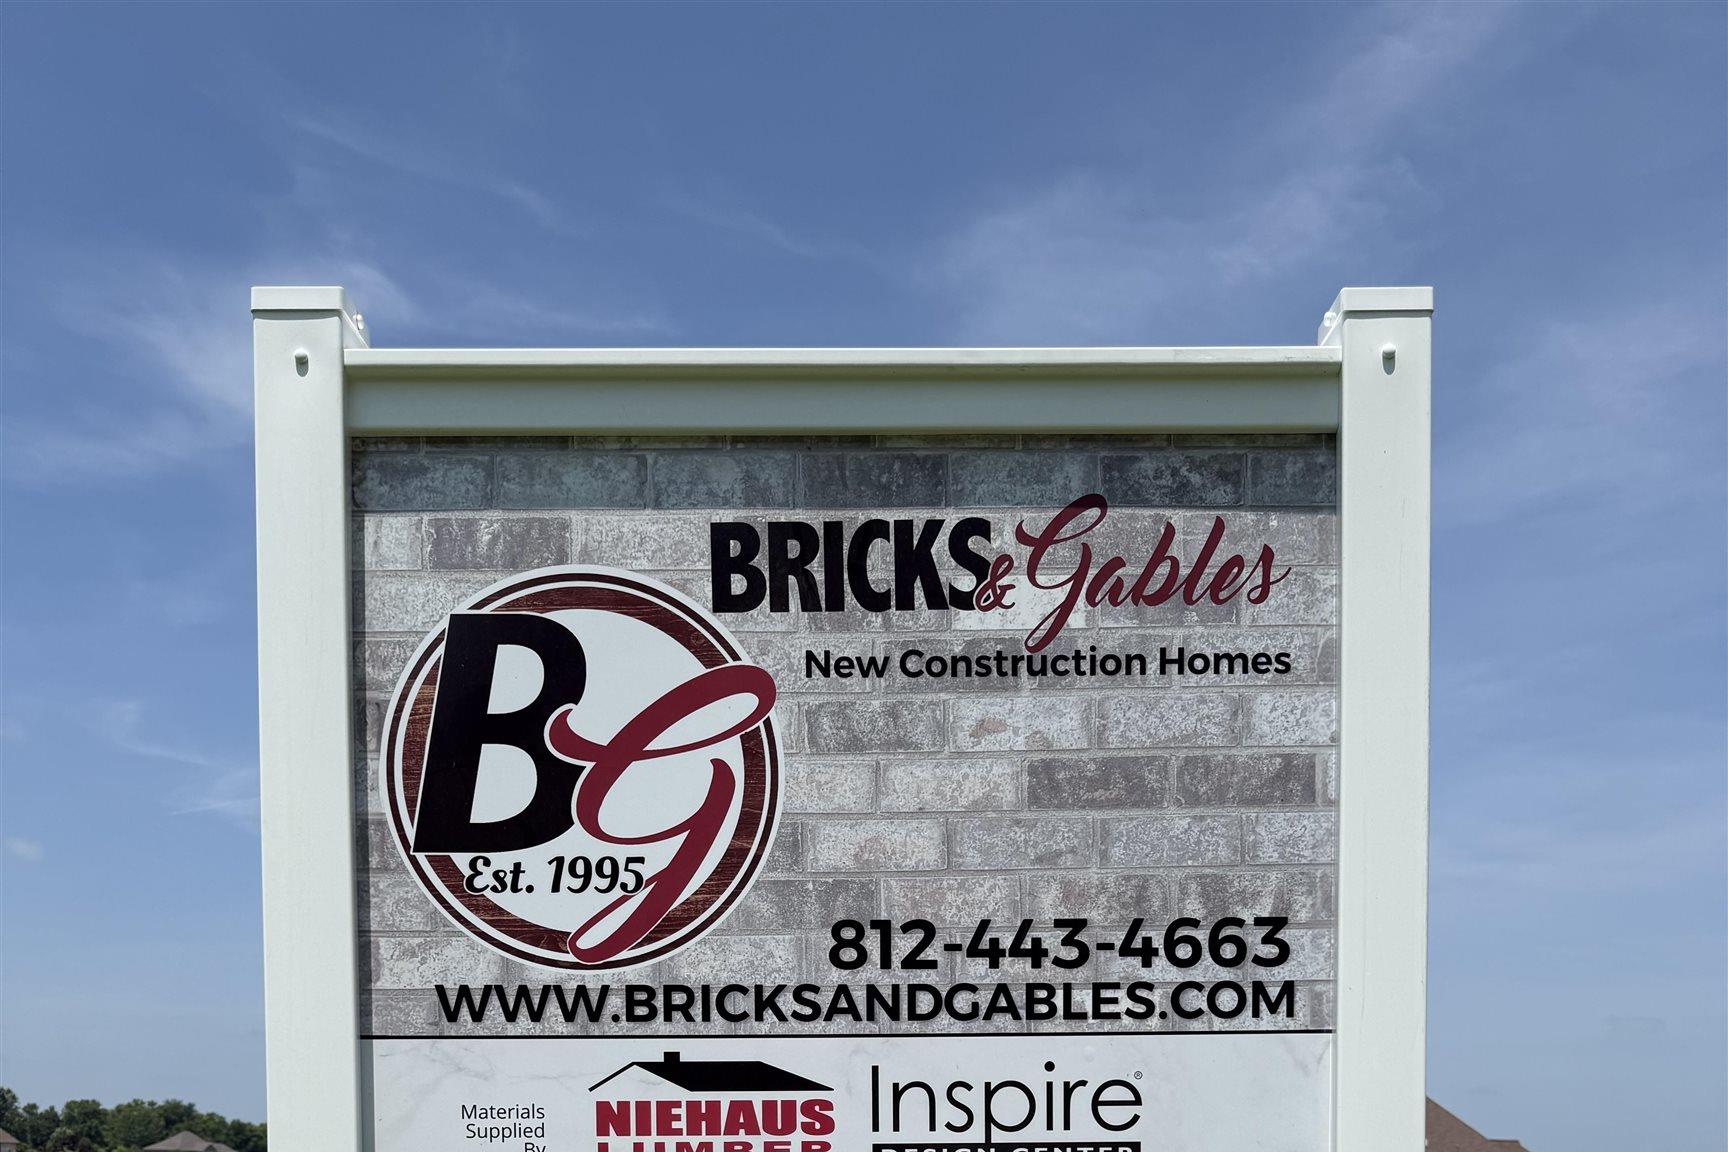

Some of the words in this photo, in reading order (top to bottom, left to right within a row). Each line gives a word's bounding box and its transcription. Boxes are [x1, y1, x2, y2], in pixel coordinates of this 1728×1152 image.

[710, 516, 993, 613] BRICKS
[975, 552, 1013, 613] &
[1015, 493, 1292, 654] Gables
[805, 650, 889, 679] New
[899, 647, 1147, 679] Construction
[1158, 646, 1292, 676] Homes
[465, 855, 535, 894] Est.
[548, 855, 646, 894] 1995
[828, 915, 1291, 970] 812-443-4663
[434, 979, 1297, 1023] WWW.BRICKSANDGABLES.COM
[461, 1104, 545, 1120] Materials
[596, 1098, 835, 1138] NIEHAUS
[871, 1061, 1143, 1144] Inspire
[466, 1123, 545, 1142] Supplied
